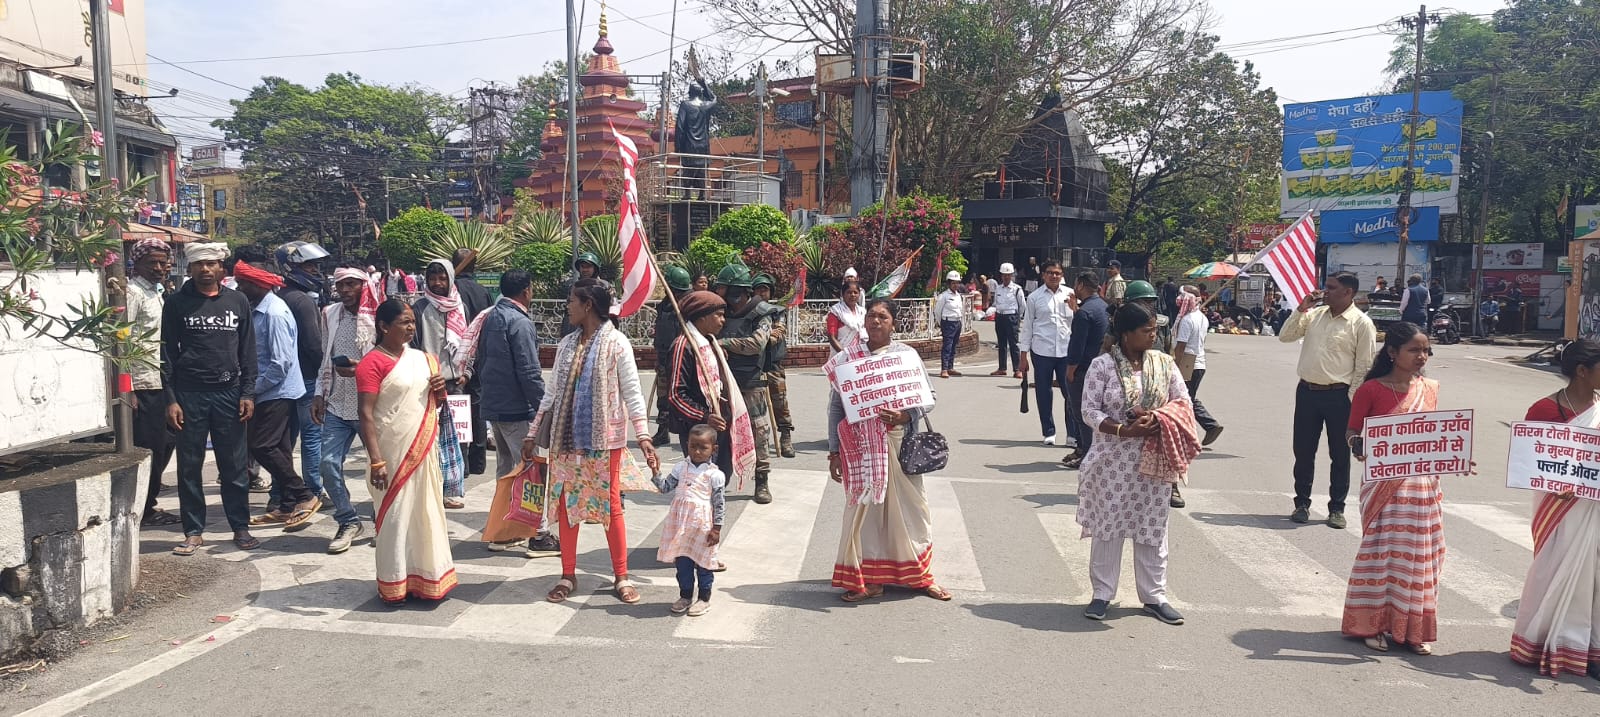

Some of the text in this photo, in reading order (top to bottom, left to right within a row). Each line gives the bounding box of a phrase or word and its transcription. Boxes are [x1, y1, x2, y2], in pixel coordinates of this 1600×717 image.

[1328, 98, 1376, 117] मेधा दही
[196, 148, 216, 158] GOAL
[841, 380, 854, 393] की
[855, 372, 884, 389] धार्मिक
[849, 382, 922, 406] से खिलवाड़ करना
[858, 406, 871, 418] बंद
[890, 397, 904, 409] बंद
[905, 393, 922, 406] करो
[1368, 412, 1471, 438] बाबा कार्तिक उराँव
[1514, 424, 1600, 446] सिरम टोली सरना
[1372, 436, 1464, 458] की भावनाओं से
[1534, 440, 1545, 454] के
[1548, 444, 1574, 458] मुख्य
[1576, 449, 1593, 461] द्वार
[1370, 455, 1466, 478] खेलना बंद करो।
[1536, 459, 1599, 480] फ्लाई ओवर
[524, 481, 544, 496] CITI
[1530, 475, 1545, 488] को
